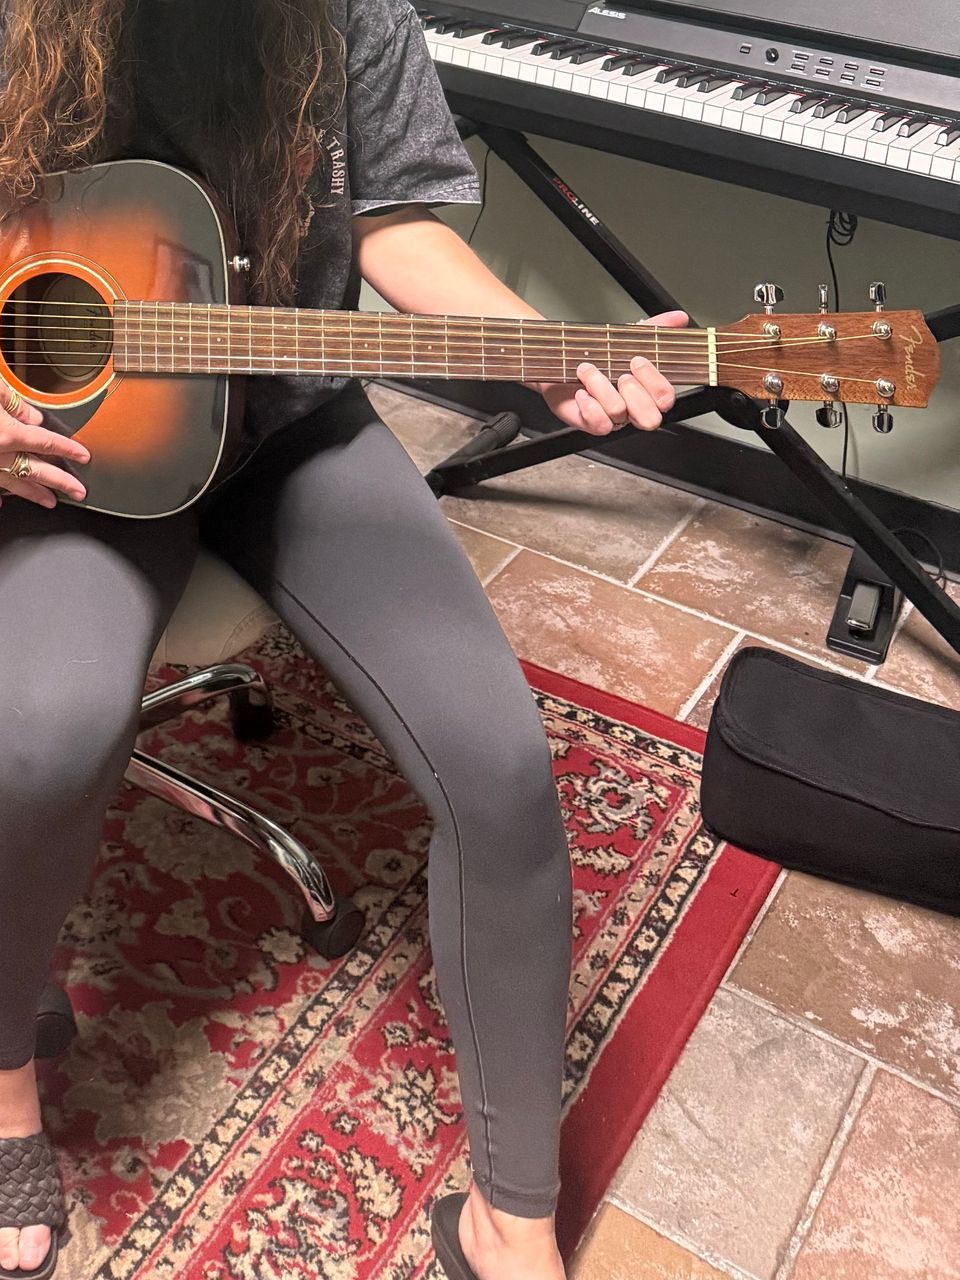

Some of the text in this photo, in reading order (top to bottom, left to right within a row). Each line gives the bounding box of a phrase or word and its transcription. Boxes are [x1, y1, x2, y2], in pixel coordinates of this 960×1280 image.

[587, 6, 627, 20] ALESIS
[325, 136, 346, 196] TRASHY
[898, 324, 926, 392] Fender
